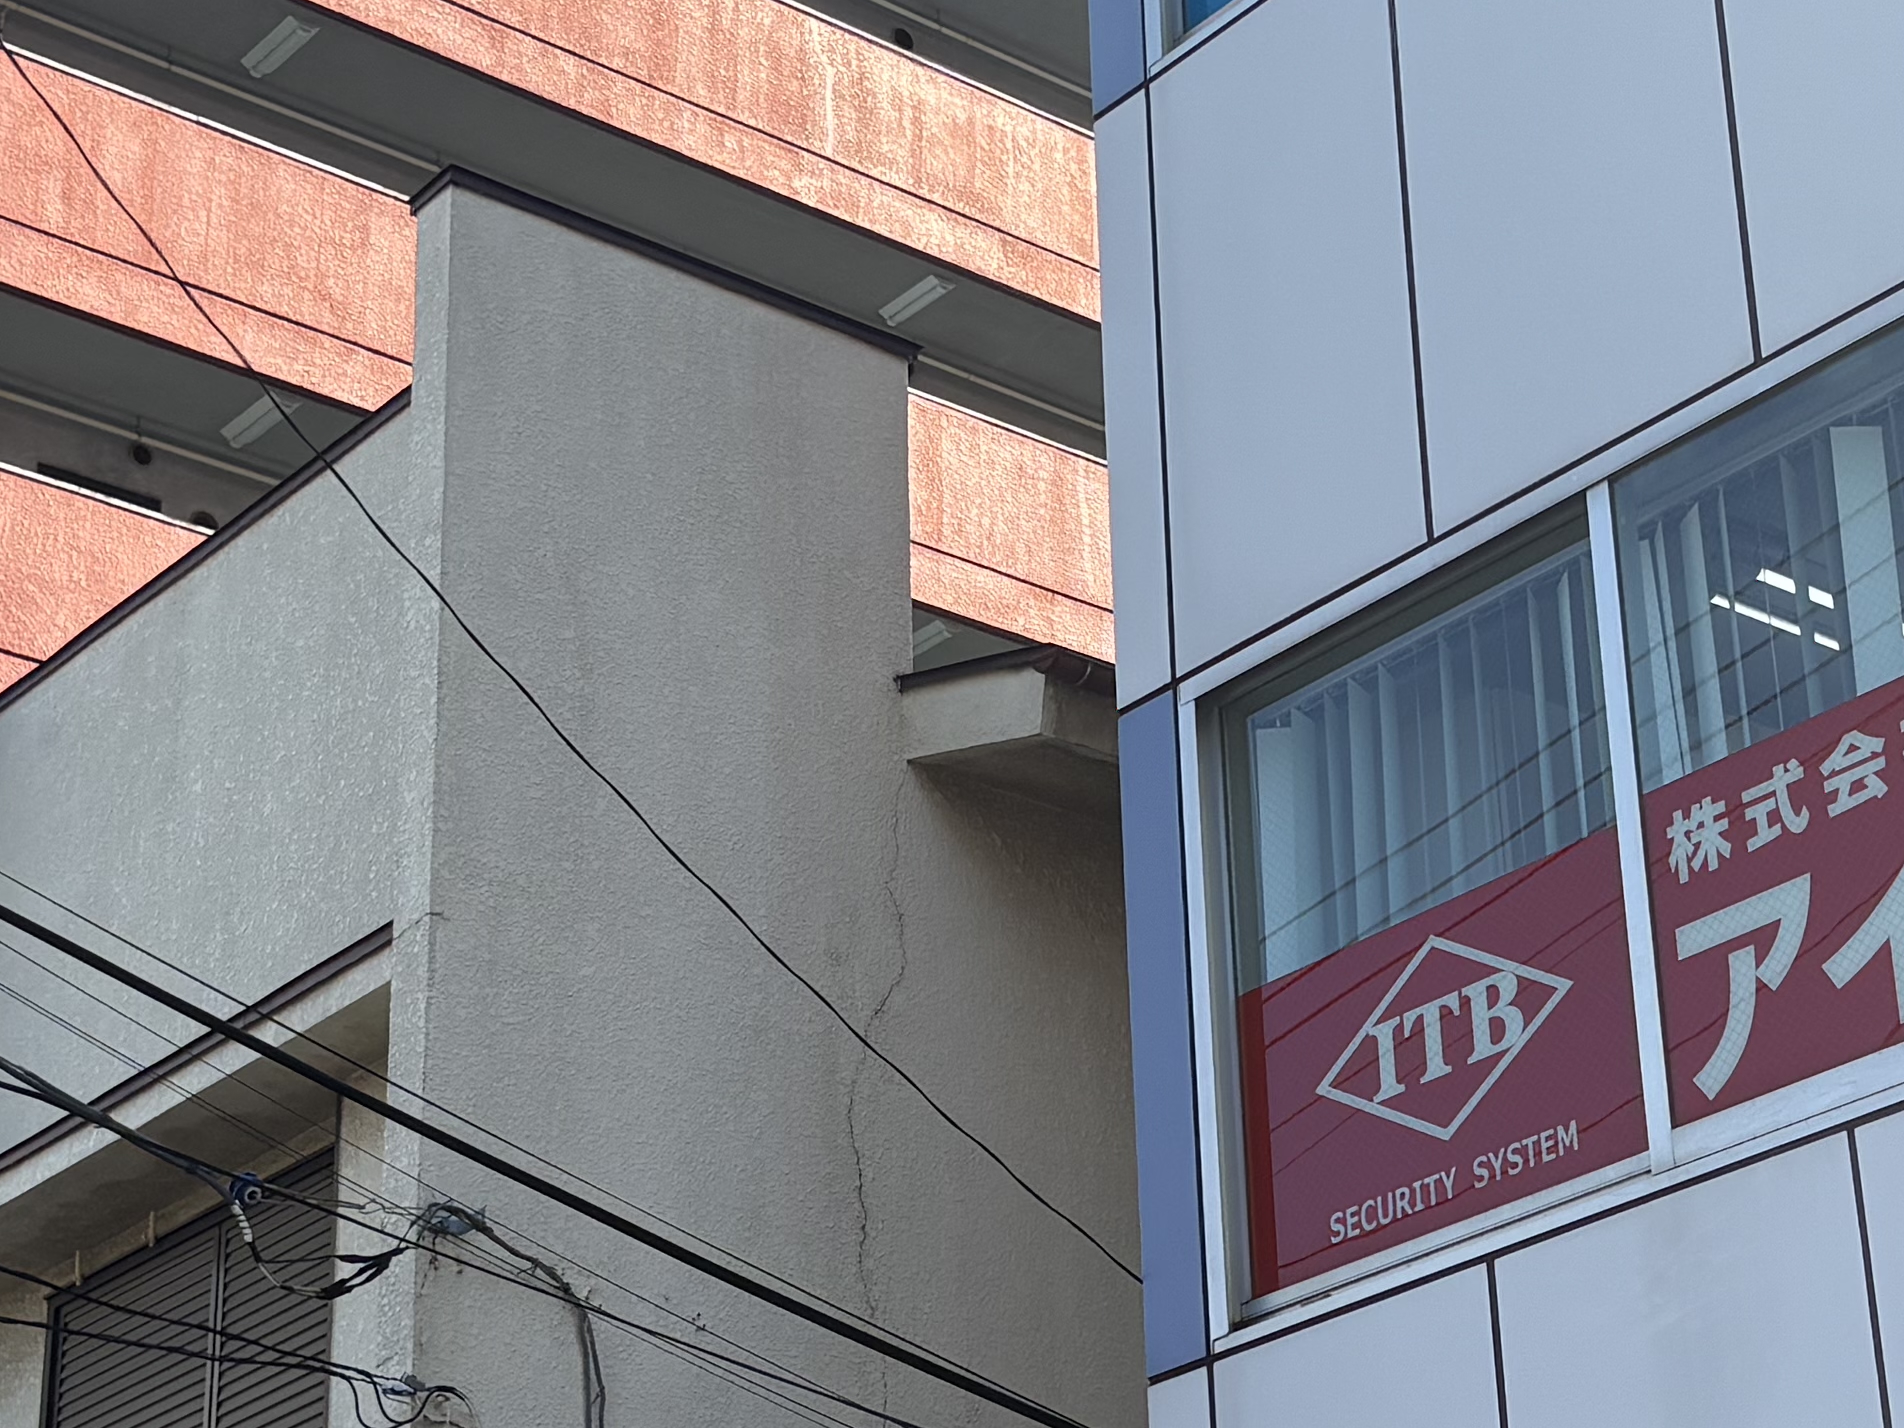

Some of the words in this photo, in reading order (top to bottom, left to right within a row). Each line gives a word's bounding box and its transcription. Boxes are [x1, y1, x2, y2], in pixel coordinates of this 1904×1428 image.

[1366, 970, 1526, 1106] ITB
[1328, 1167, 1457, 1245] SECURITY
[1473, 1118, 1580, 1190] SYSTEM
